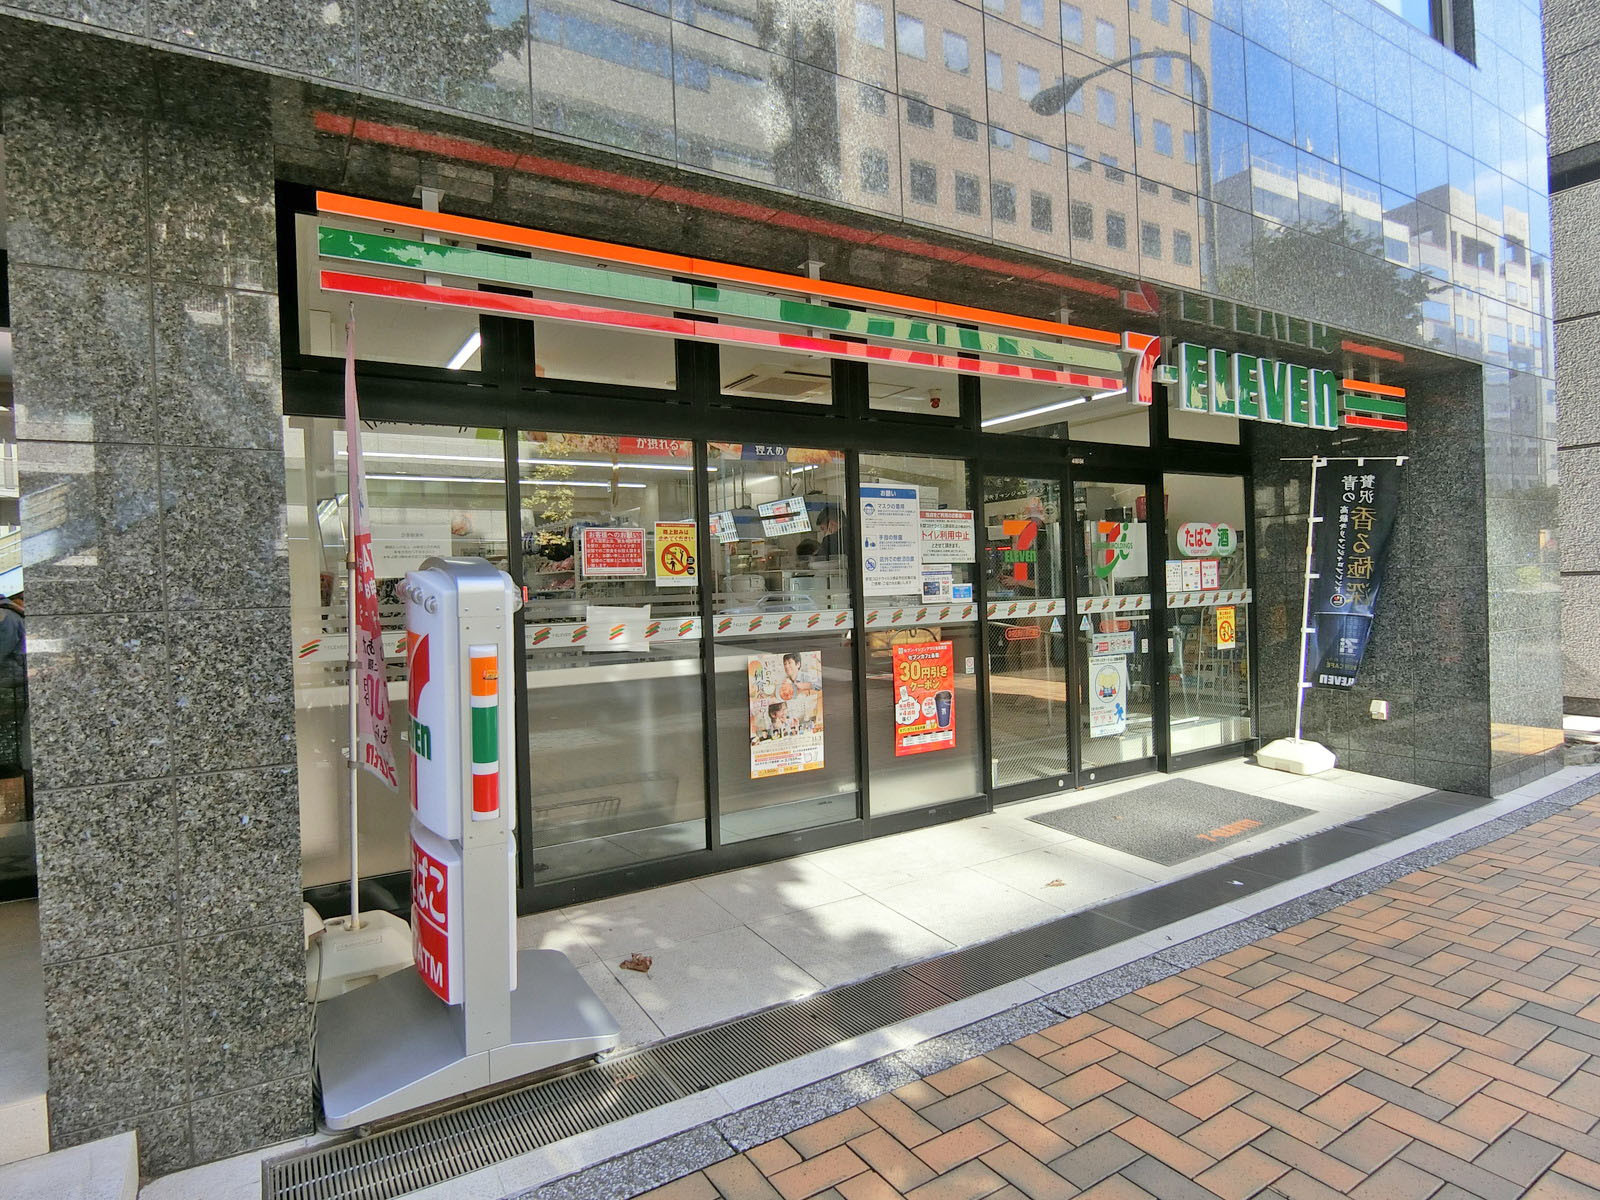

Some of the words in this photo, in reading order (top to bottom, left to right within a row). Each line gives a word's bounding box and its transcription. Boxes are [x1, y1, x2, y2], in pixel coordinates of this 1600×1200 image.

[921, 530, 970, 541] トイレ利用中止
[1185, 528, 1213, 547] たばこ
[1217, 528, 1229, 547] 酒
[901, 661, 949, 681] 30円引き
[910, 681, 940, 692] クーポン
[417, 941, 444, 989] ATM
